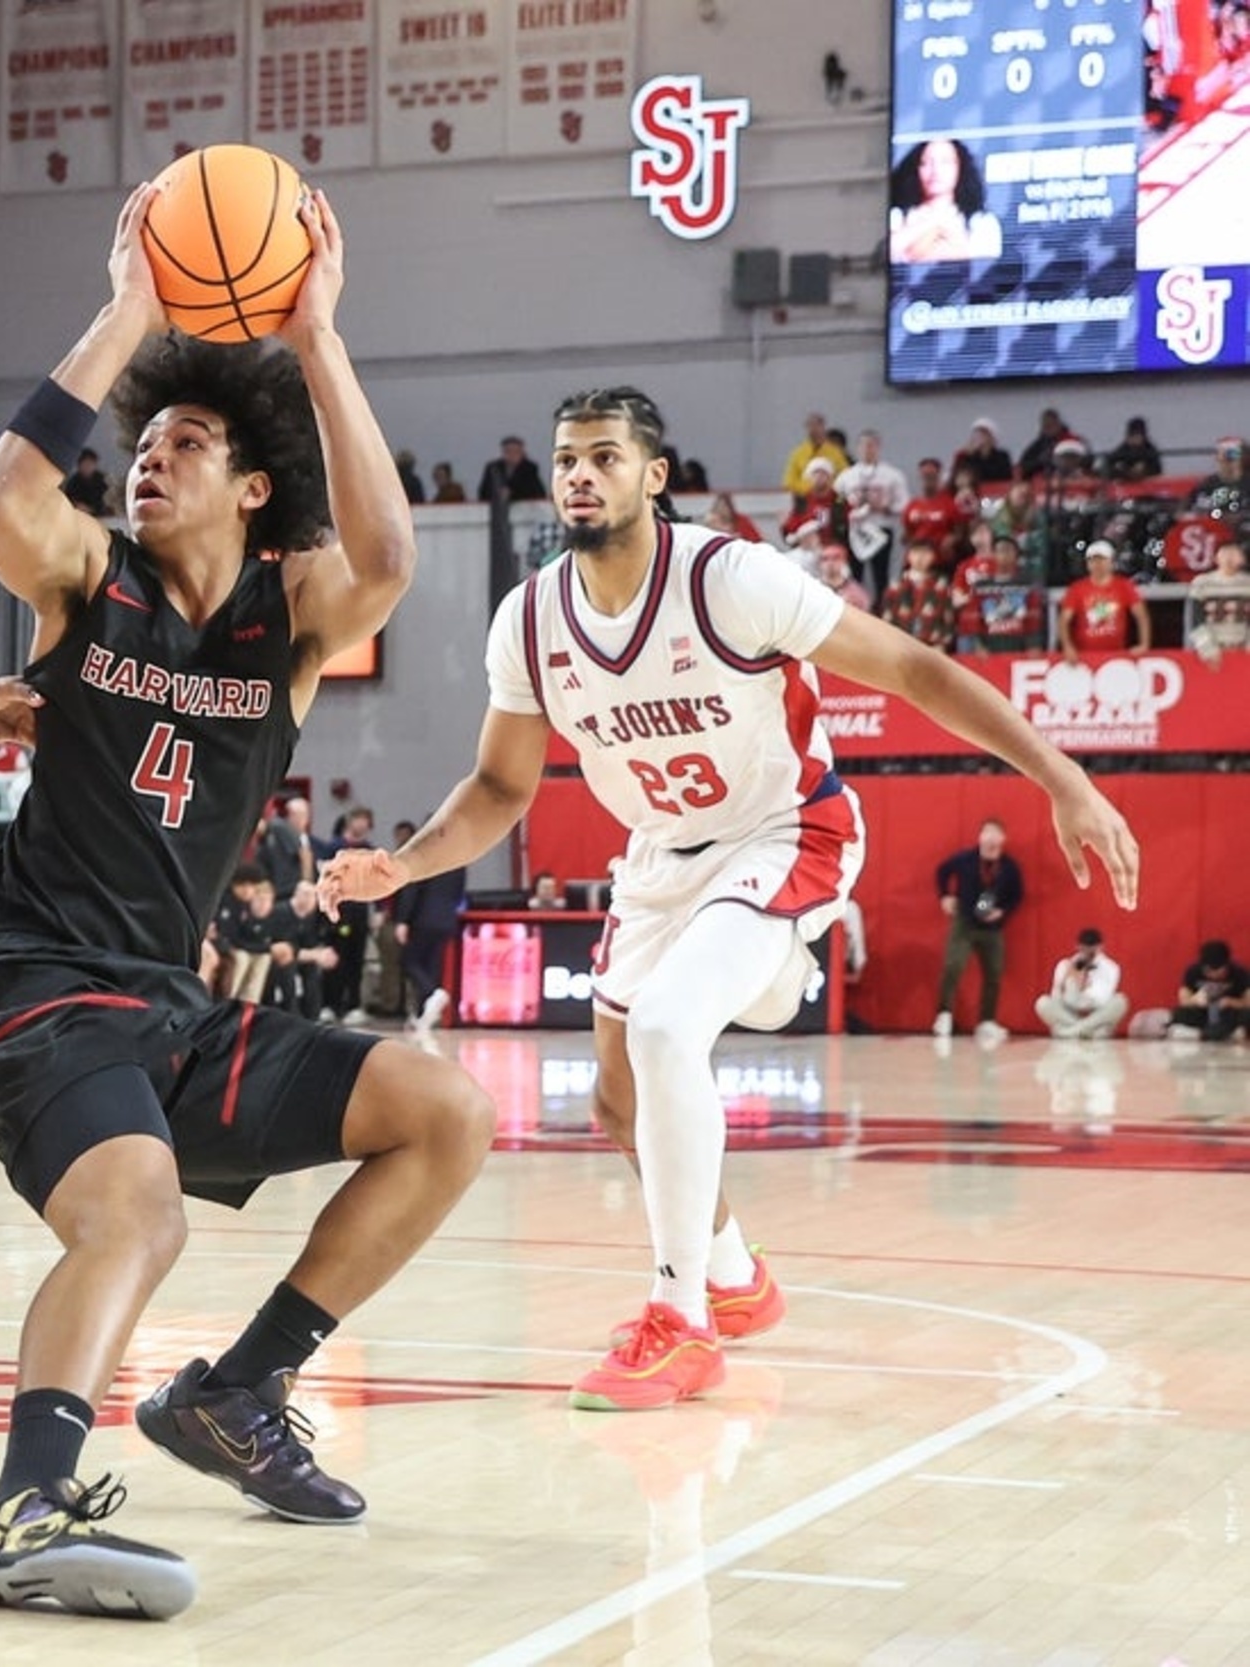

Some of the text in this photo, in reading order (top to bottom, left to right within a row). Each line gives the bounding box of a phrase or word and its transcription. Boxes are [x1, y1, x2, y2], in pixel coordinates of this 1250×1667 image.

[400, 11, 486, 43] SWEET 16
[518, 2, 565, 30] ELITE
[933, 52, 1105, 99] 0 0 0
[80, 642, 273, 719] HARVARD
[1011, 658, 1184, 717] FOOD
[610, 694, 732, 745] JOHN'S
[131, 721, 194, 829] 4
[626, 753, 729, 816] 23
